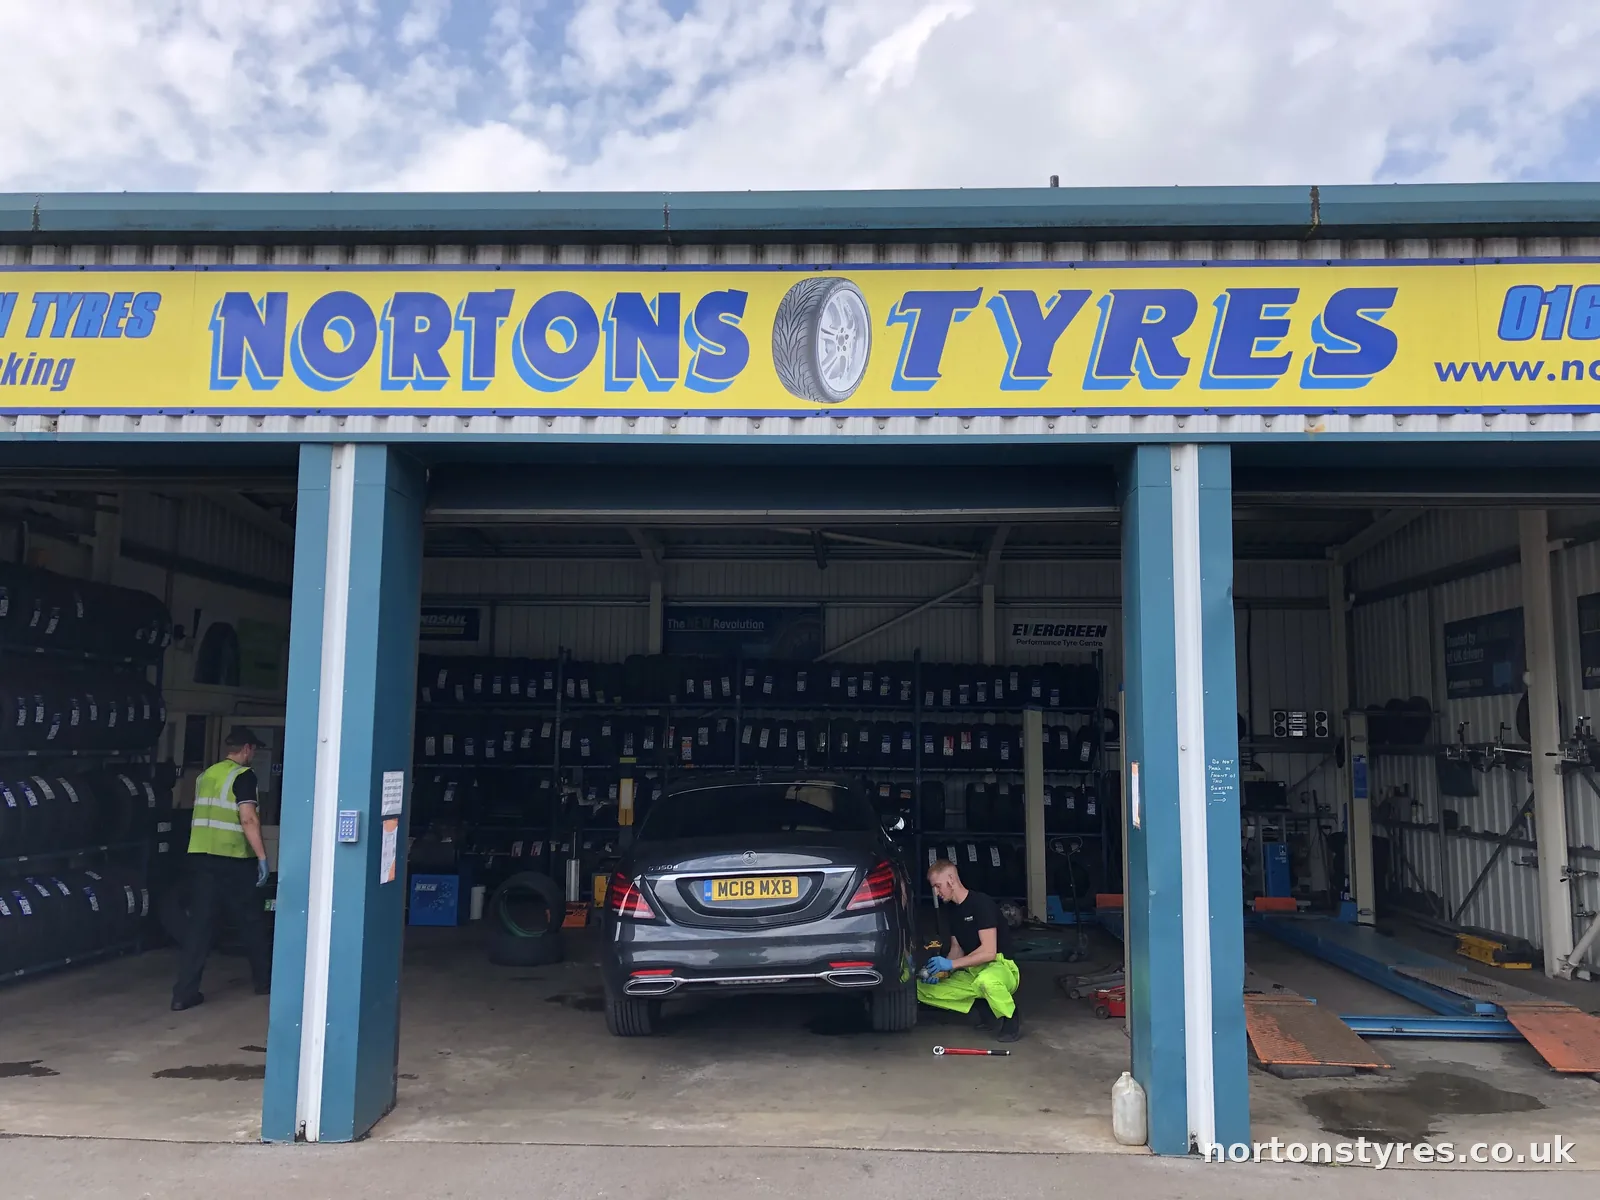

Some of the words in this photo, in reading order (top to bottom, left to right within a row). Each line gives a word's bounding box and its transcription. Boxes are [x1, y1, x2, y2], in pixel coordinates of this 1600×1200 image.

[25, 292, 162, 338] TYRES
[210, 288, 750, 393] NORTONS
[886, 286, 1399, 392] TYRES
[0, 352, 76, 391] king
[667, 618, 685, 629] The
[686, 615, 712, 629] NEW
[713, 618, 765, 629] Revolution
[1012, 623, 1108, 637] EVERGREEN
[1016, 638, 1062, 647] Performance
[1062, 639, 1077, 647] Tyre
[717, 880, 755, 897] MC18
[759, 879, 792, 896] MXB
